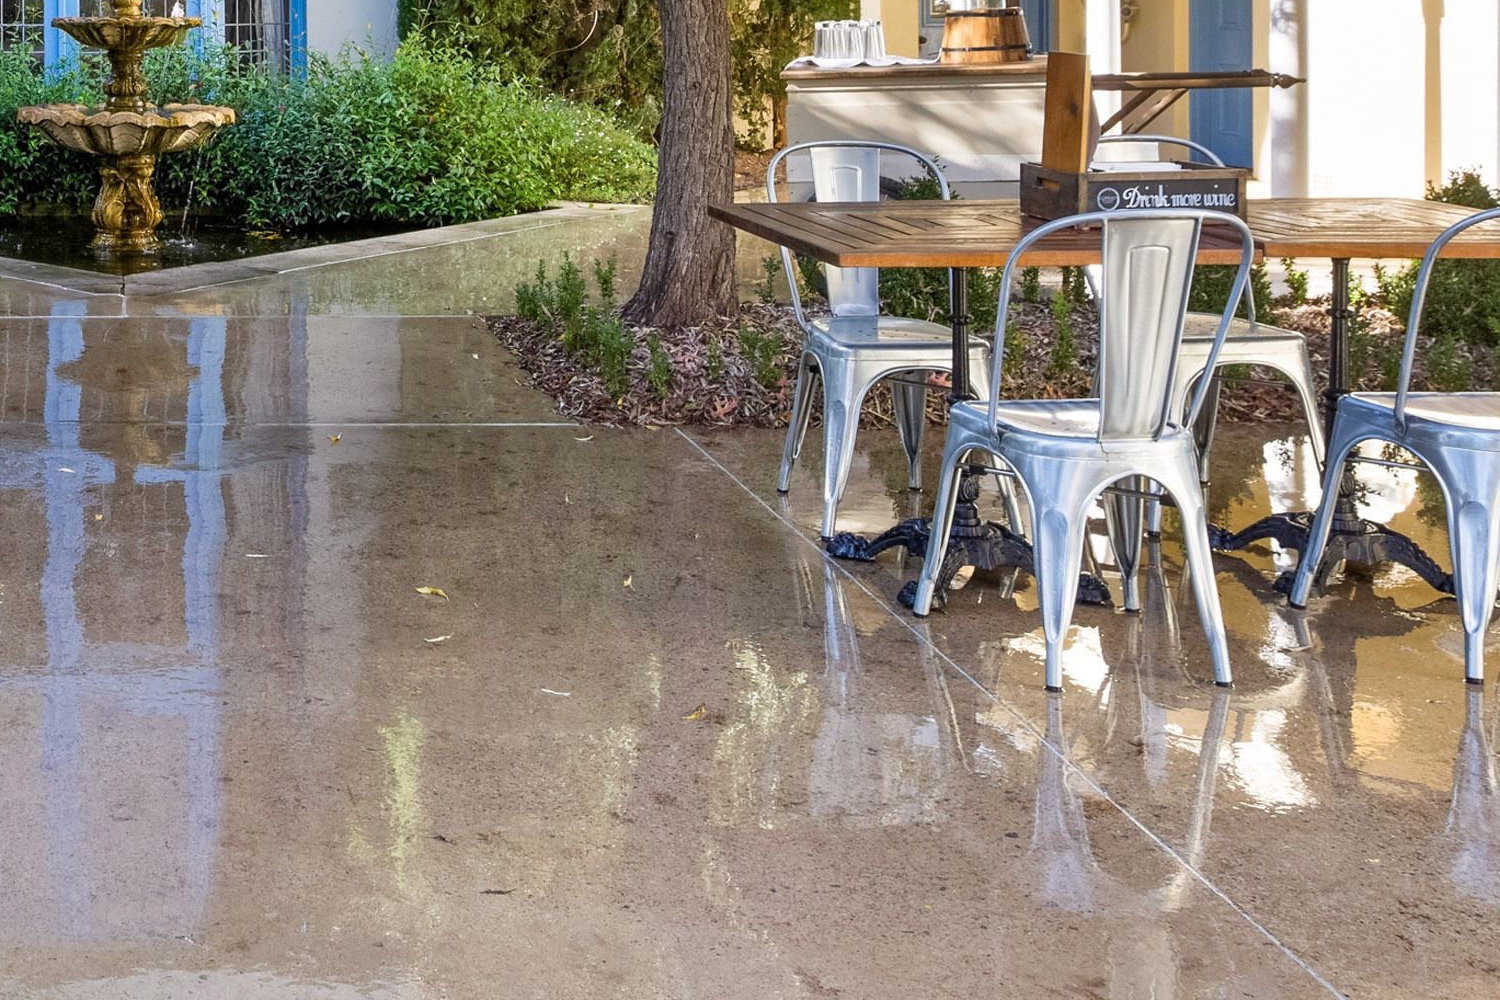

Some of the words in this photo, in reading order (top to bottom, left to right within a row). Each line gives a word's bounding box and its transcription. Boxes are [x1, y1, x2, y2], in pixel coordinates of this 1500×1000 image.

[1122, 184, 1171, 208] Drink
[1170, 193, 1202, 207] more
[1203, 184, 1236, 207] wine
